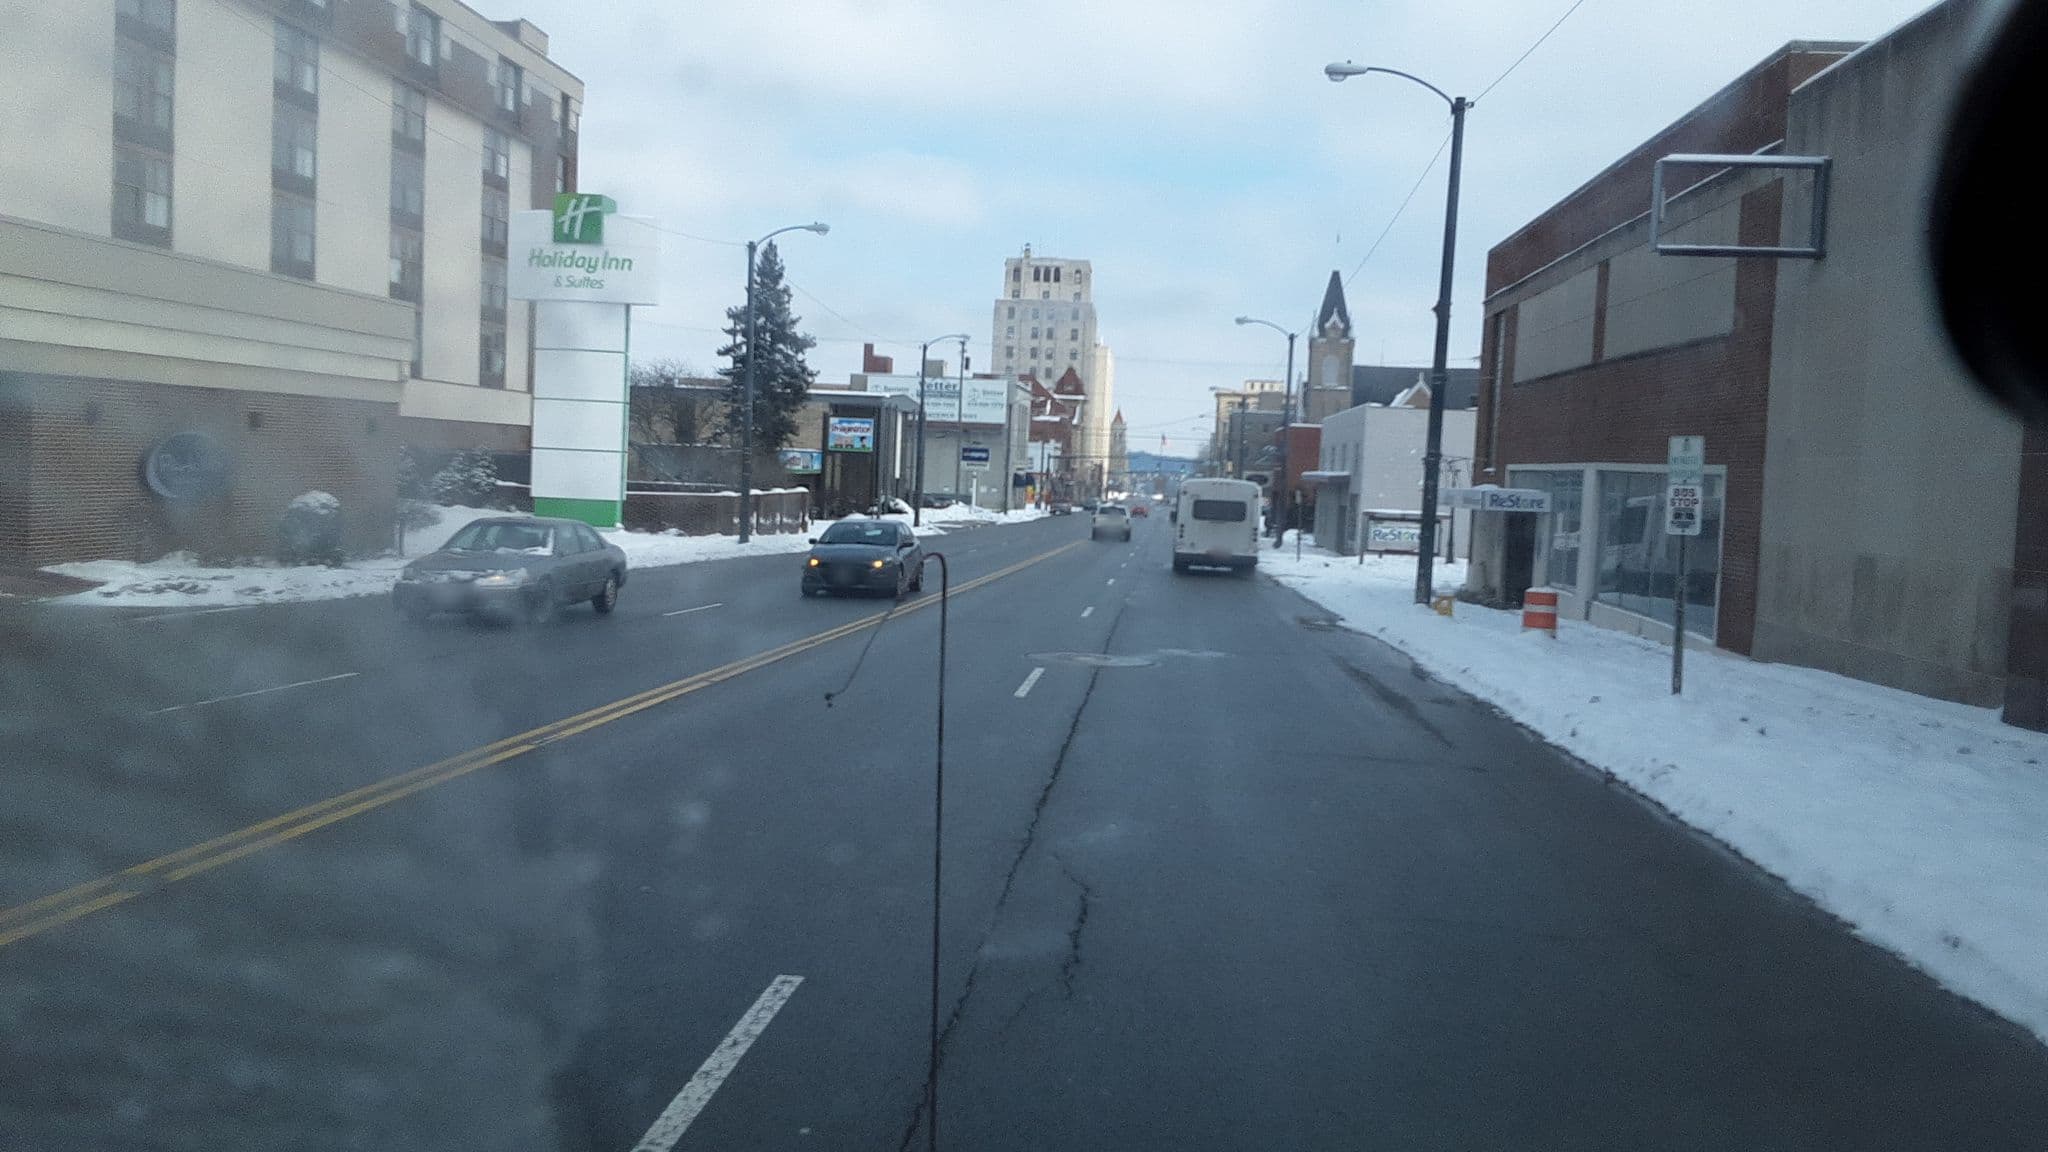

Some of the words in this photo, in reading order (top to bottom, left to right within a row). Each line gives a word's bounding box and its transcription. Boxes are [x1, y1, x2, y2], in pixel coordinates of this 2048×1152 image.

[528, 247, 599, 273] Holiday
[602, 250, 633, 271] Inn
[553, 276, 562, 287] &
[566, 275, 605, 289] Suites
[1673, 488, 1695, 497] BUS
[1489, 494, 1545, 509] ReStore
[1670, 498, 1699, 507] STOP
